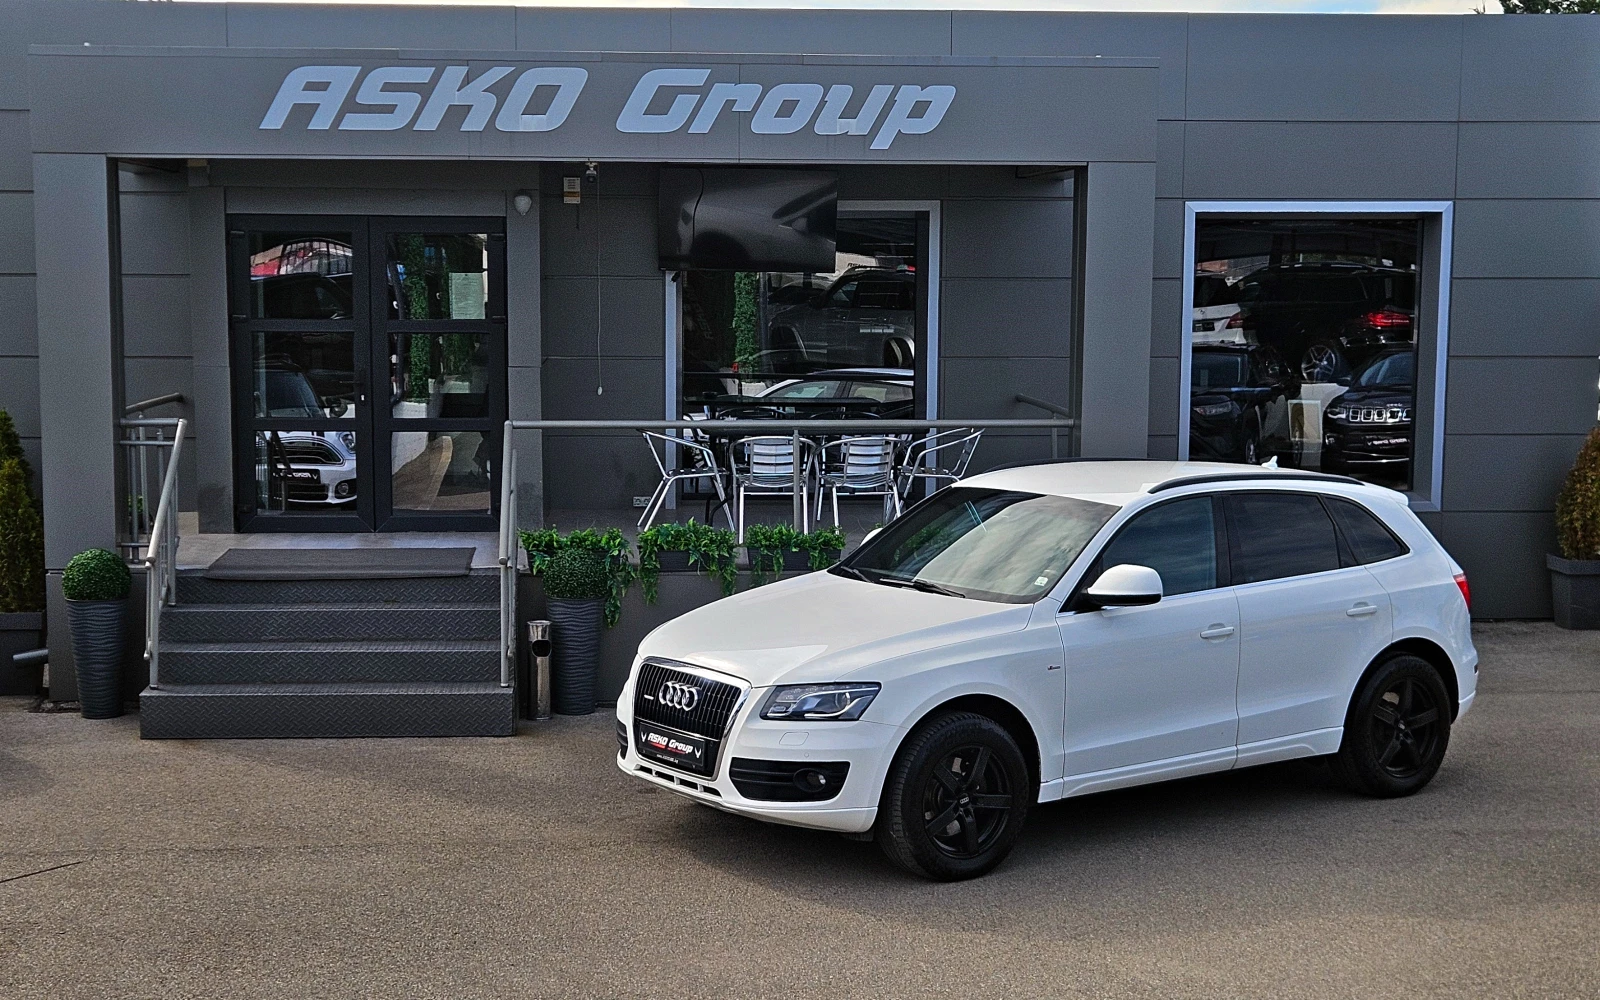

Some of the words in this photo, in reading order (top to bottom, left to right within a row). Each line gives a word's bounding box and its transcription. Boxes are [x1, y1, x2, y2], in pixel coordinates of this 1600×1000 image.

[259, 66, 589, 132] ASKO
[615, 69, 956, 150] Group
[648, 732, 668, 745] ASKO
[668, 739, 693, 754] Group
